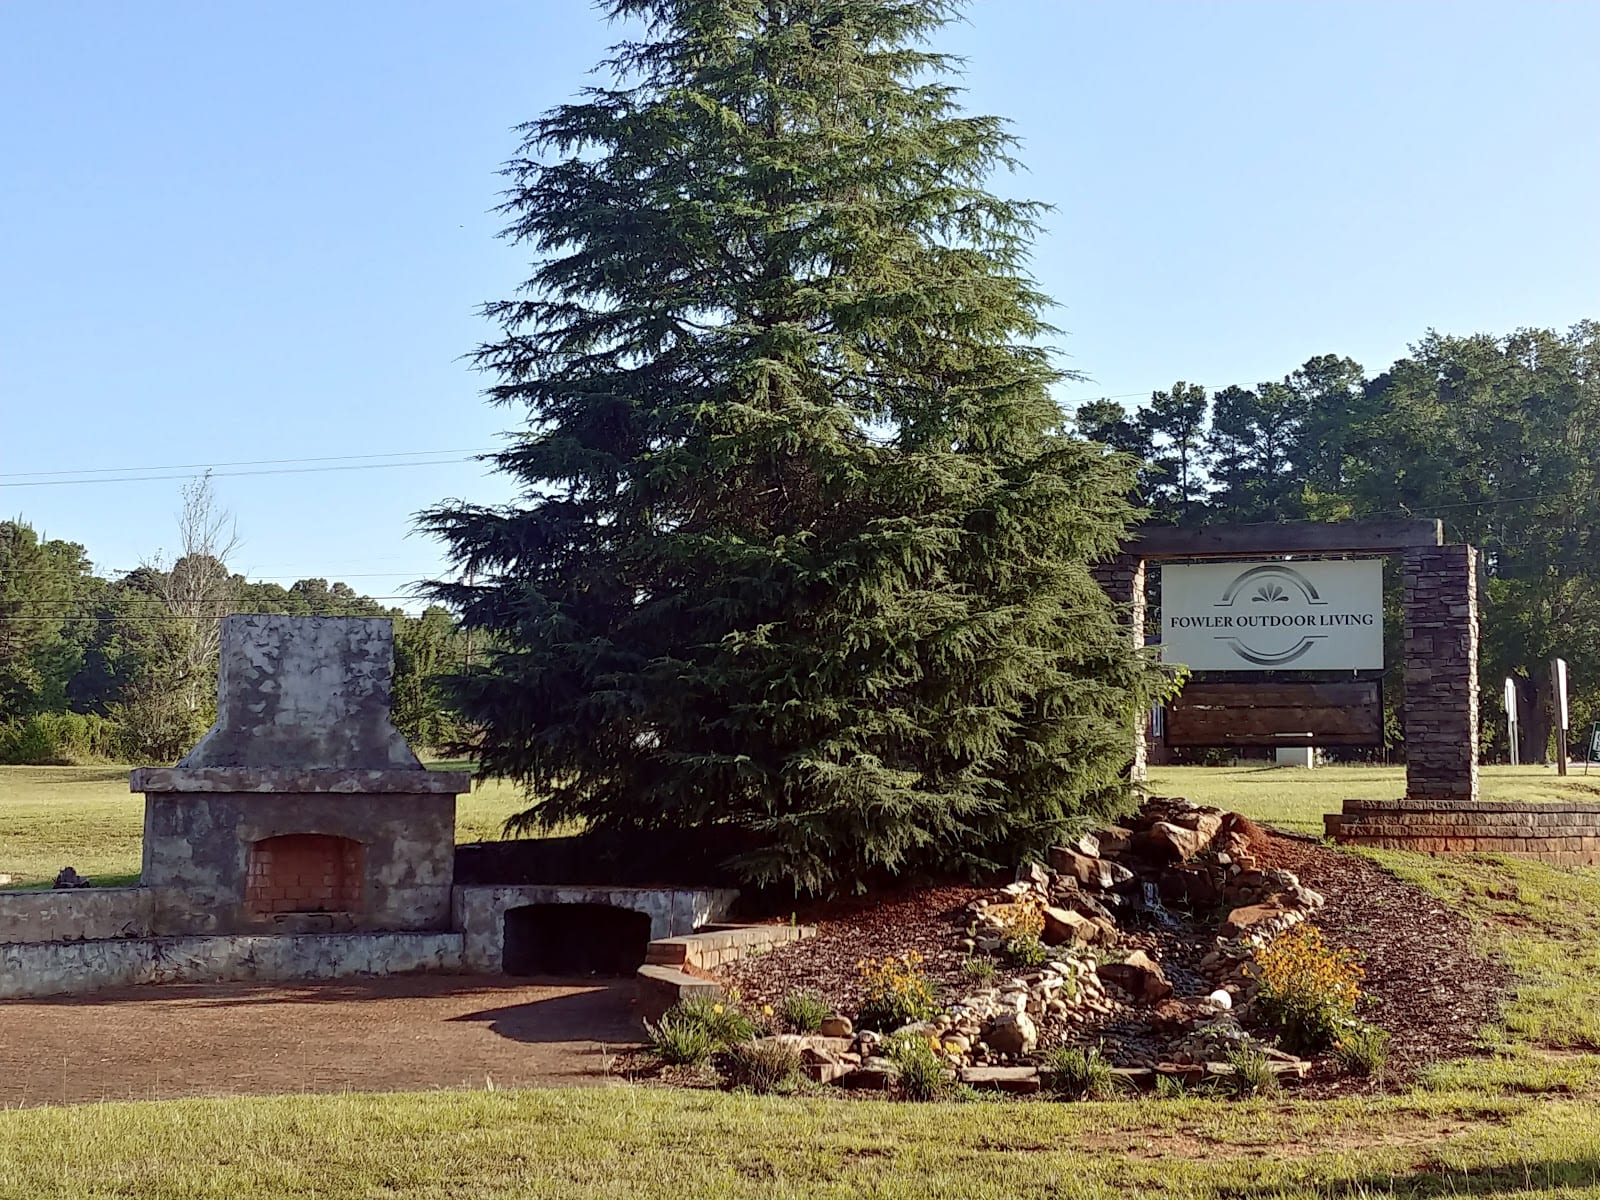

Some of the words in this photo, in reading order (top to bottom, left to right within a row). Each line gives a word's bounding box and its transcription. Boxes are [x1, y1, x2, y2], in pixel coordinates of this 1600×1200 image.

[1170, 616, 1233, 628] FOWLER
[1236, 615, 1317, 627] OUTDOOR
[1320, 614, 1374, 626] LIVING
